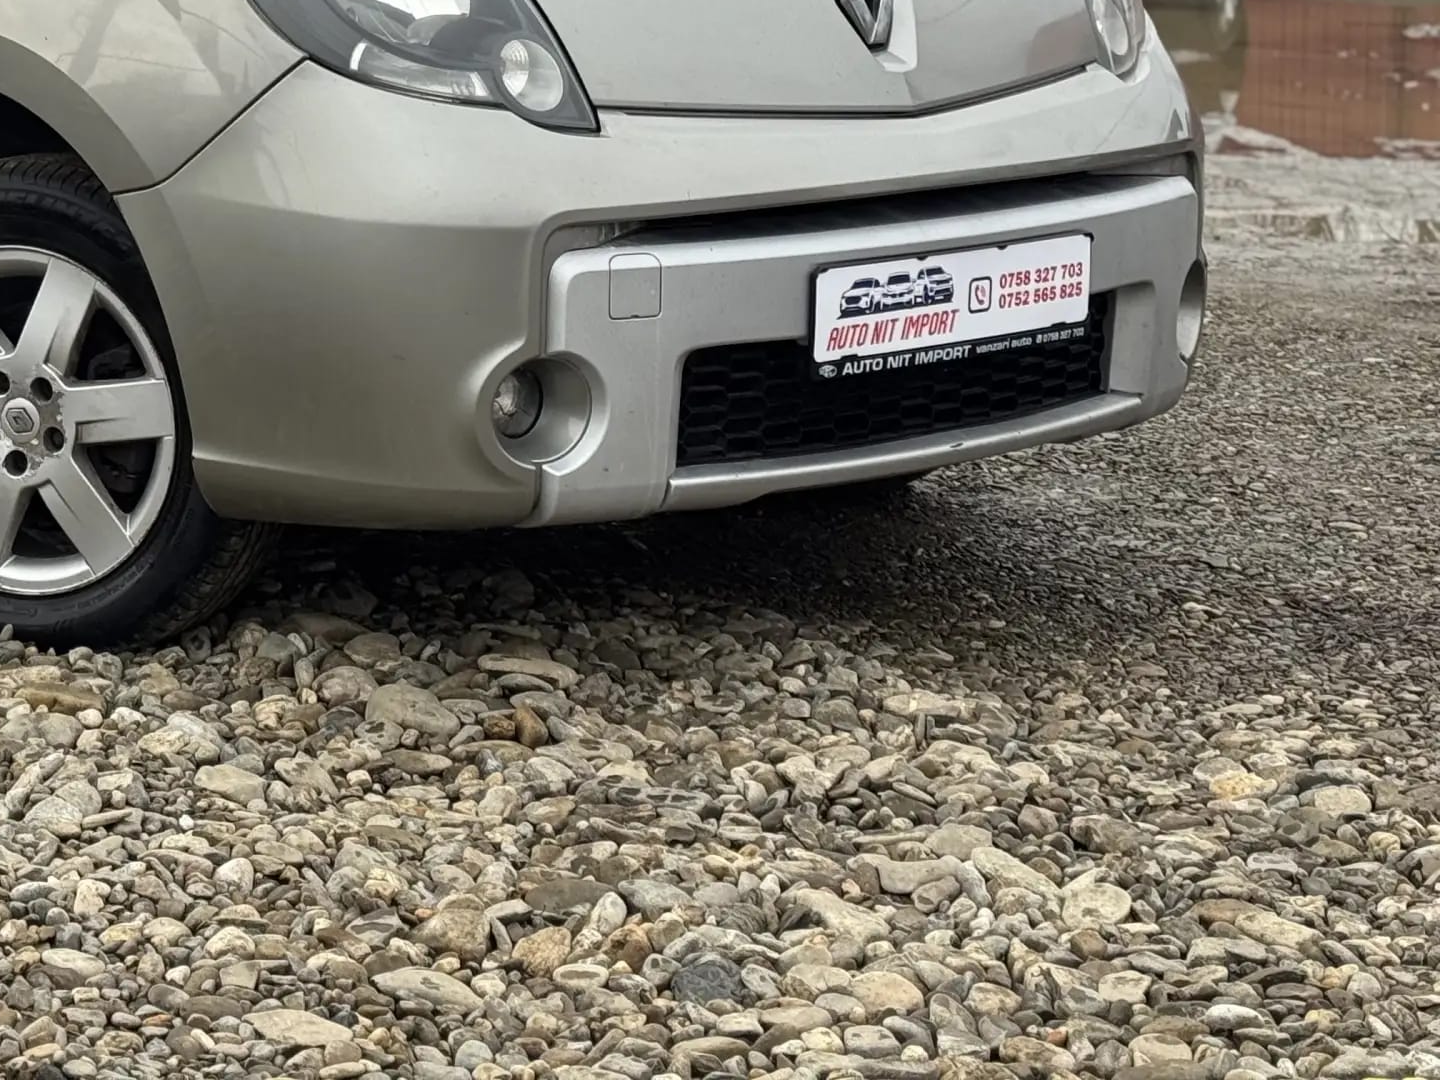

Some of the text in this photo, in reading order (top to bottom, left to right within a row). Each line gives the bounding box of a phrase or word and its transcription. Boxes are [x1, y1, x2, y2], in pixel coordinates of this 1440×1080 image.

[1000, 262, 1084, 289] 0758 327 703
[999, 281, 1083, 309] 0752 565 825
[826, 309, 960, 351] AUTO NIT IMPORT
[842, 358, 883, 376] AUTO
[887, 354, 912, 369] NIT
[915, 345, 972, 365] IMPORT
[1011, 337, 1033, 348] auto
